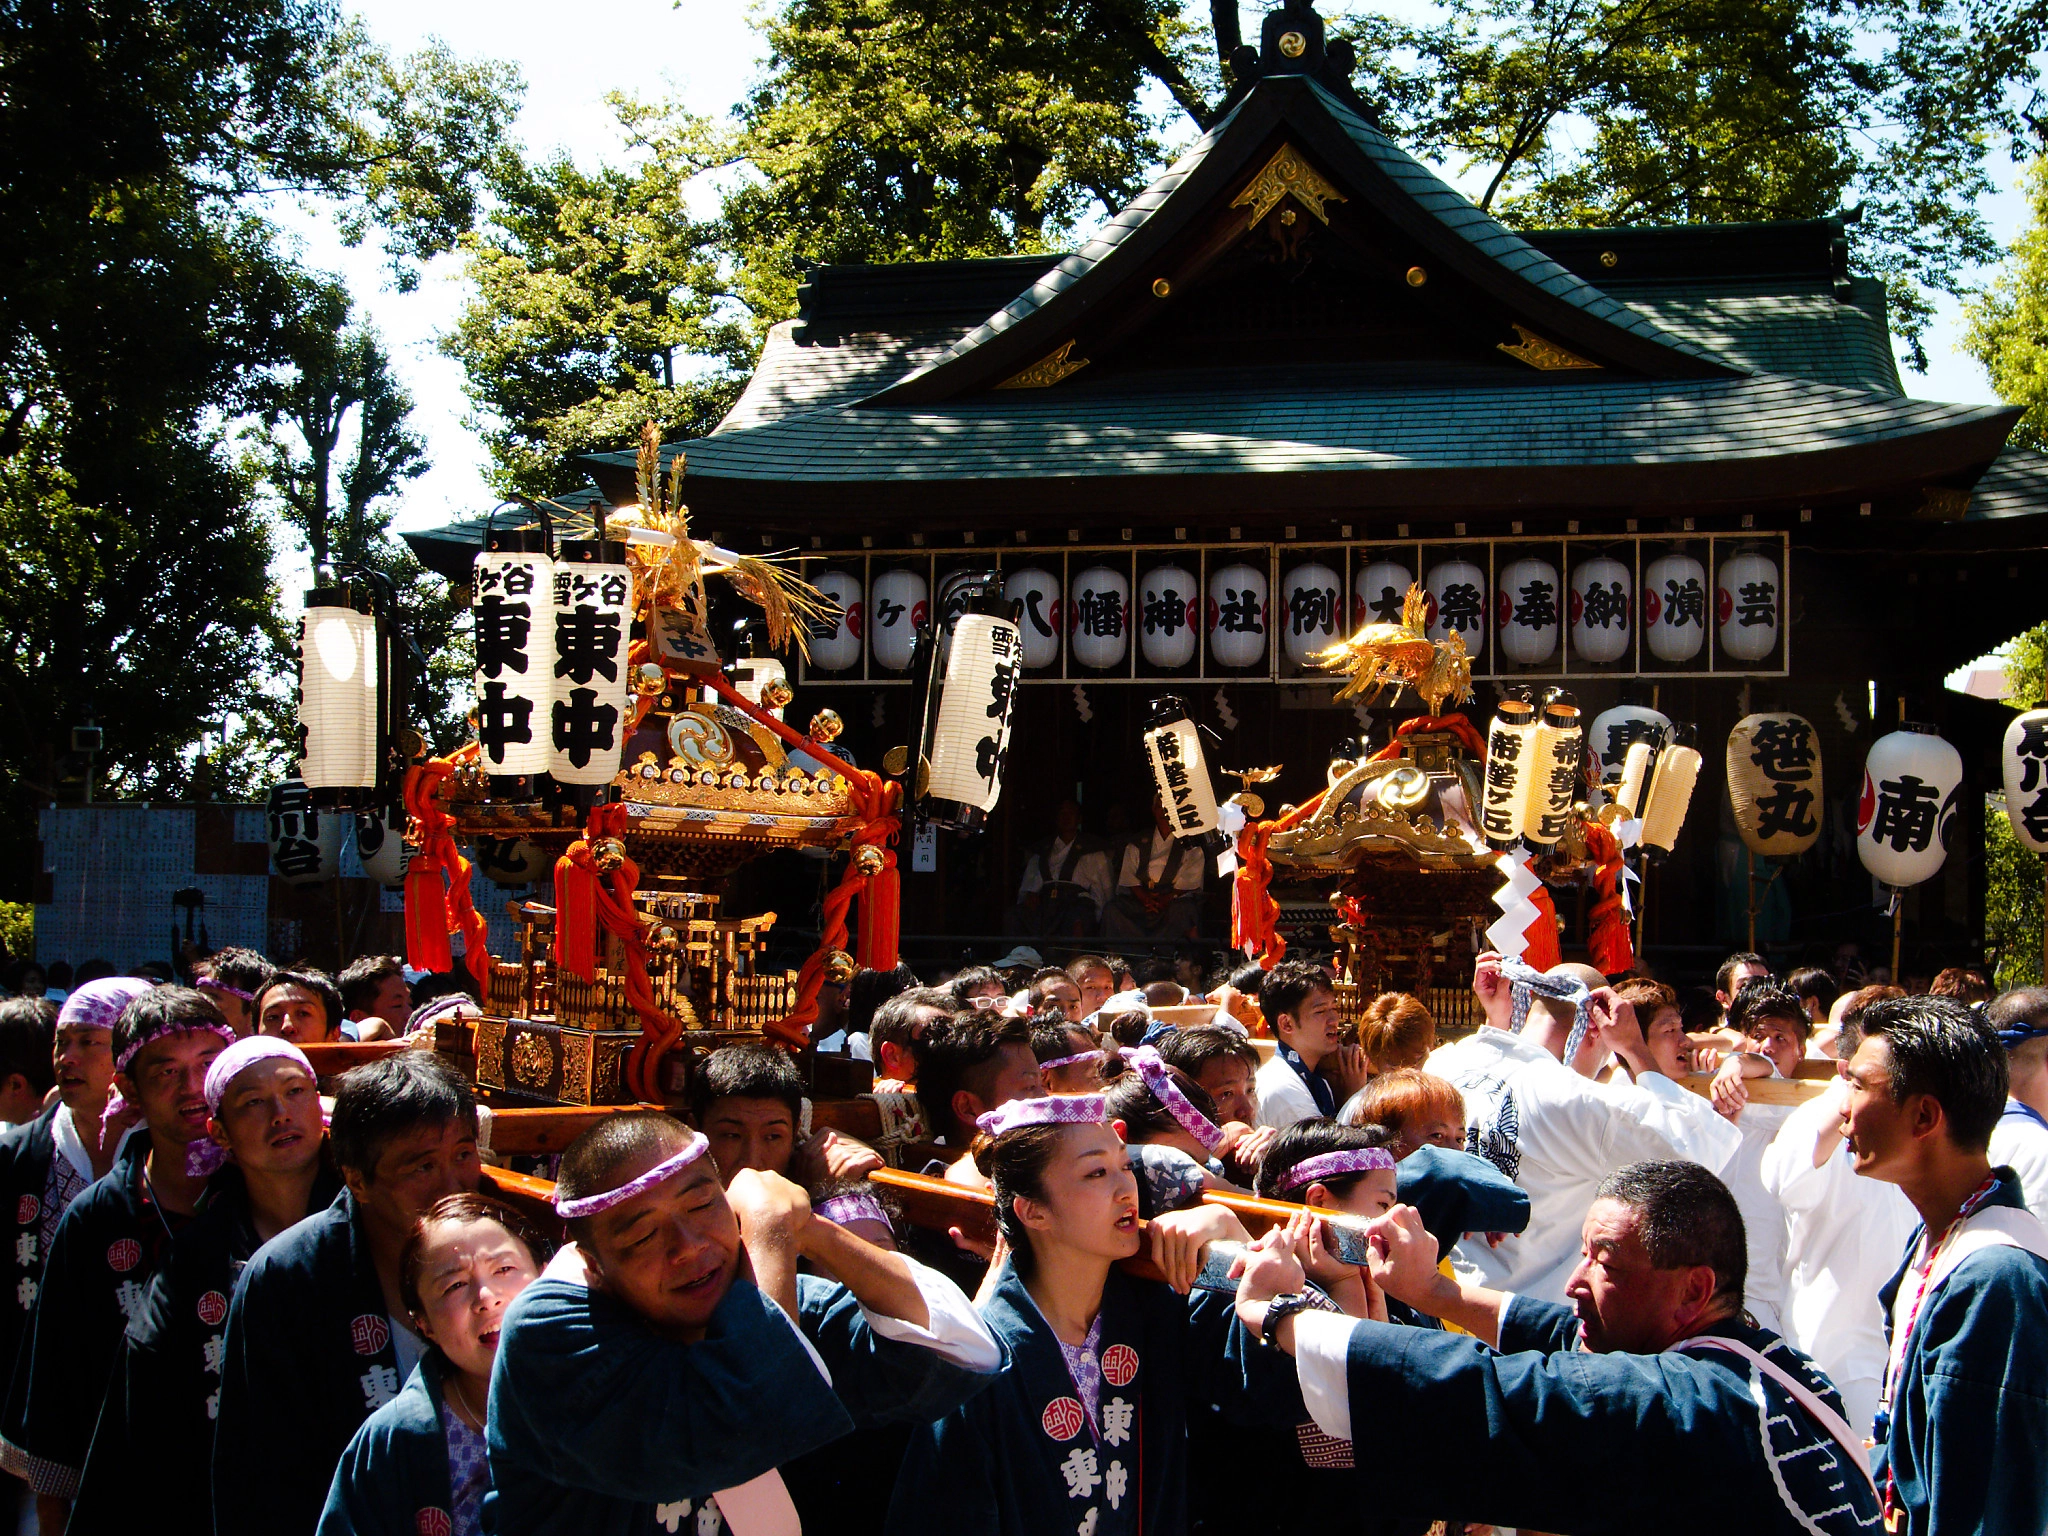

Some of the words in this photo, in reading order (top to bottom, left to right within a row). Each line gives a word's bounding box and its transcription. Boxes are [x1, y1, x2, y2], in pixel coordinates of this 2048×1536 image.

[551, 604, 622, 769] 東中
[1751, 718, 1818, 840] 笹丸
[1872, 775, 1940, 853] 南
[1103, 1397, 1135, 1510] 東中
